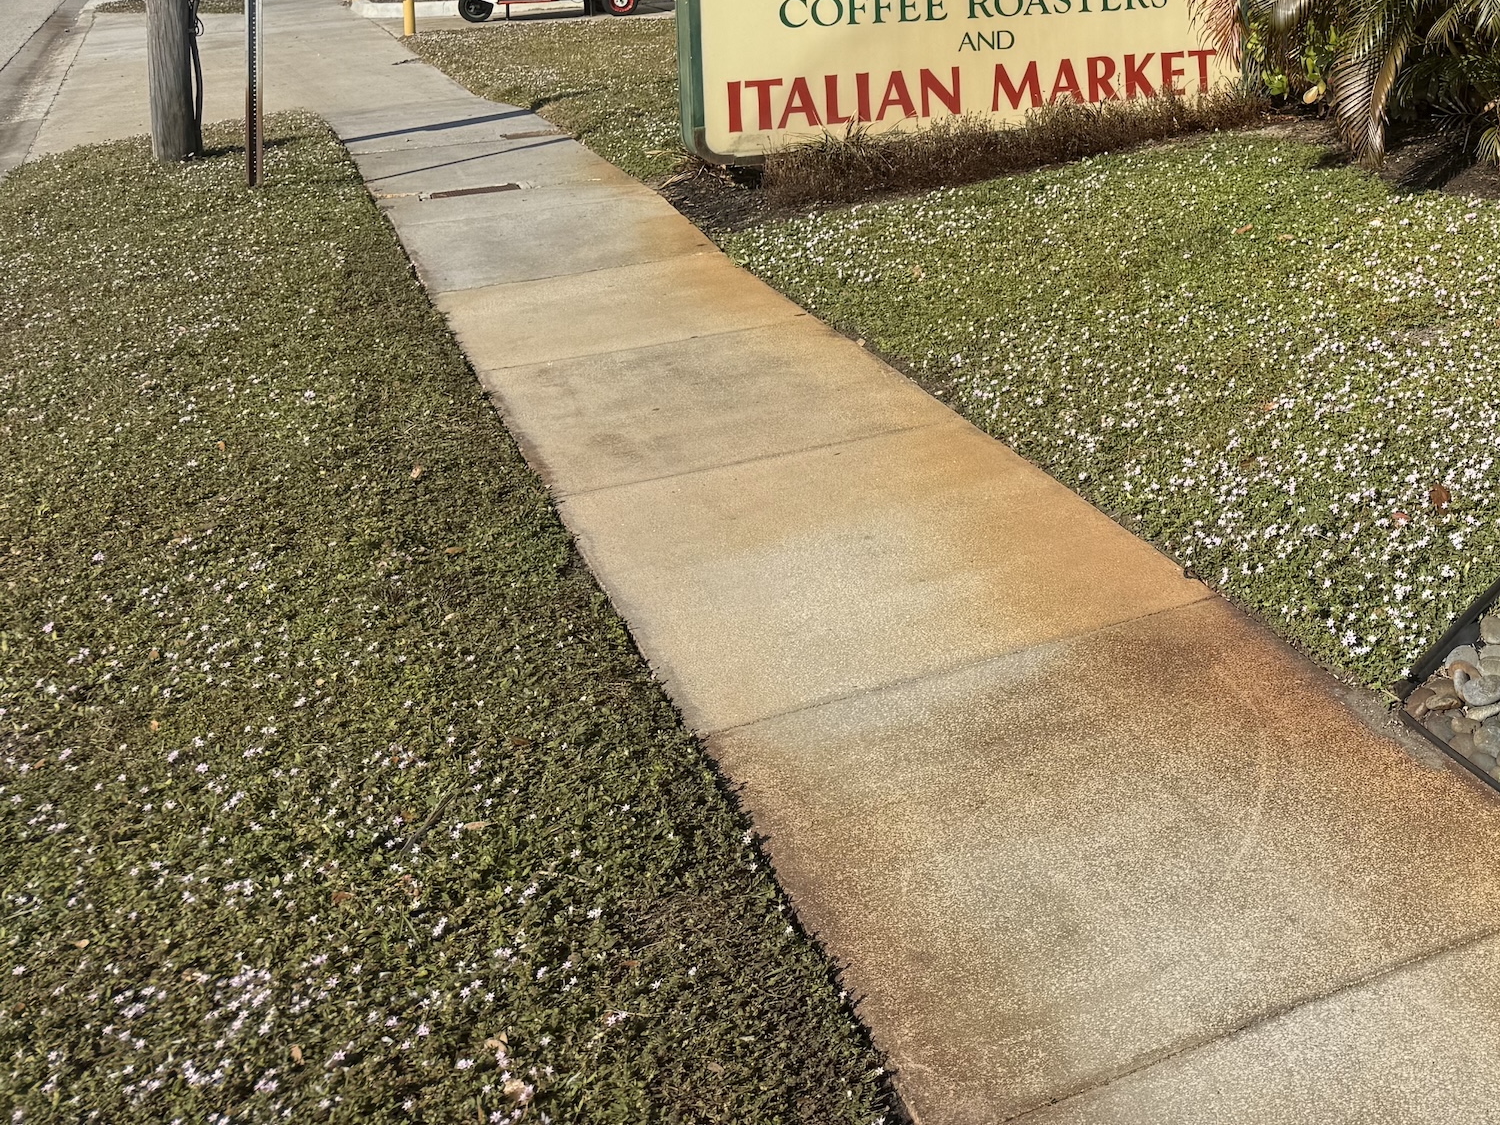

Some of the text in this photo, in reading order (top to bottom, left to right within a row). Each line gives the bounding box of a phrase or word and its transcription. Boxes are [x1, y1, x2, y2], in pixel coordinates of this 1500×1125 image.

[957, 30, 1015, 52] AND
[727, 49, 1218, 133] ITALIAN MARKET
